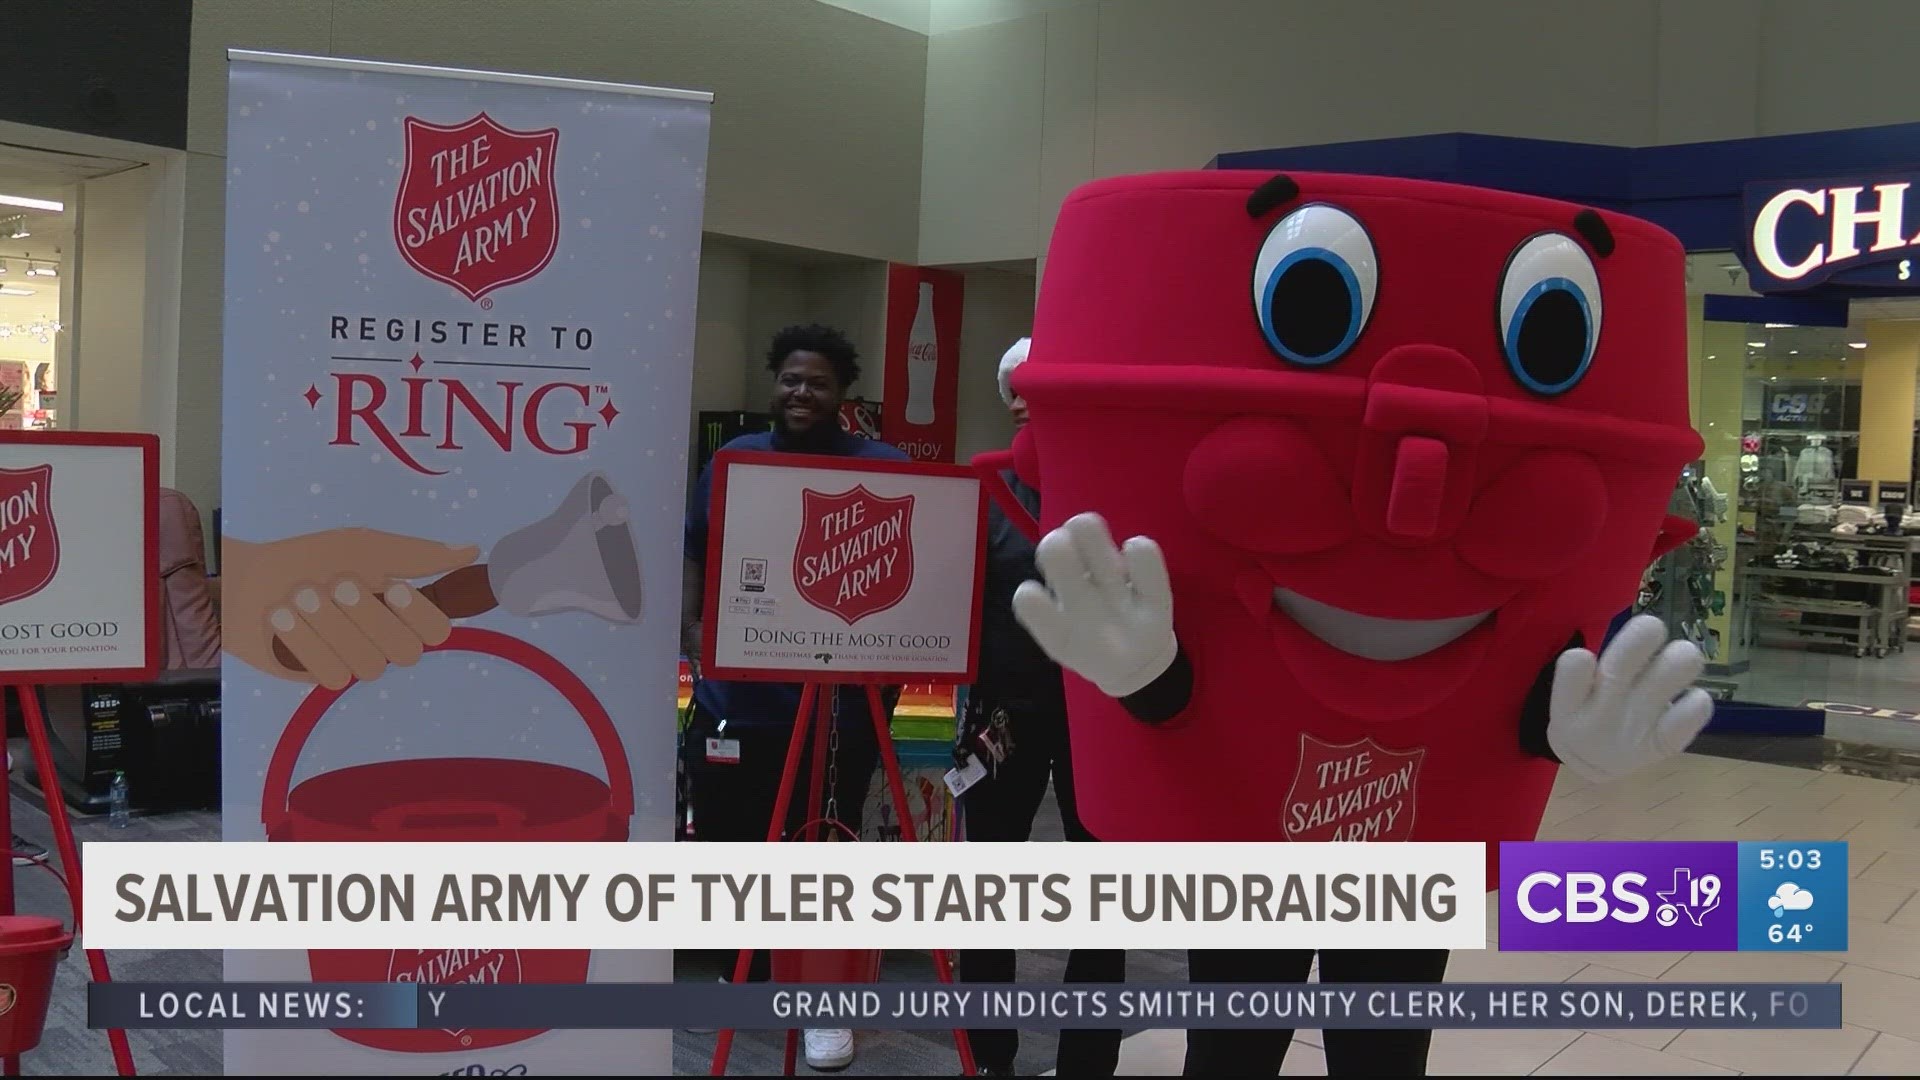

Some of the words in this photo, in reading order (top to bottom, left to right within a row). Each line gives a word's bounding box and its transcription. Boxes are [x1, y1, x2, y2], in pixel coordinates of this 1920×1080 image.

[430, 135, 492, 188] THE
[406, 147, 542, 248] SALVATION
[452, 197, 538, 275] ARMY
[1753, 182, 1920, 280] CH
[331, 316, 527, 348] REGISTER
[550, 326, 593, 351] TO
[328, 370, 598, 476] RING
[897, 438, 942, 460] enjoy
[821, 500, 866, 541] THE
[802, 509, 903, 587] SALVATION
[836, 547, 898, 606] ARMY
[0, 624, 44, 640] OST
[50, 621, 118, 639] GOOD
[21, 647, 40, 656] FOR
[41, 645, 67, 655] YOUR
[69, 644, 118, 654] DONATION
[744, 627, 807, 646] DOING
[810, 631, 843, 647] THE
[847, 633, 896, 649] MOST
[899, 635, 951, 650] GOOD
[1316, 751, 1372, 789] THE
[1288, 761, 1413, 834] SALVATION
[1331, 800, 1402, 842] ARMY
